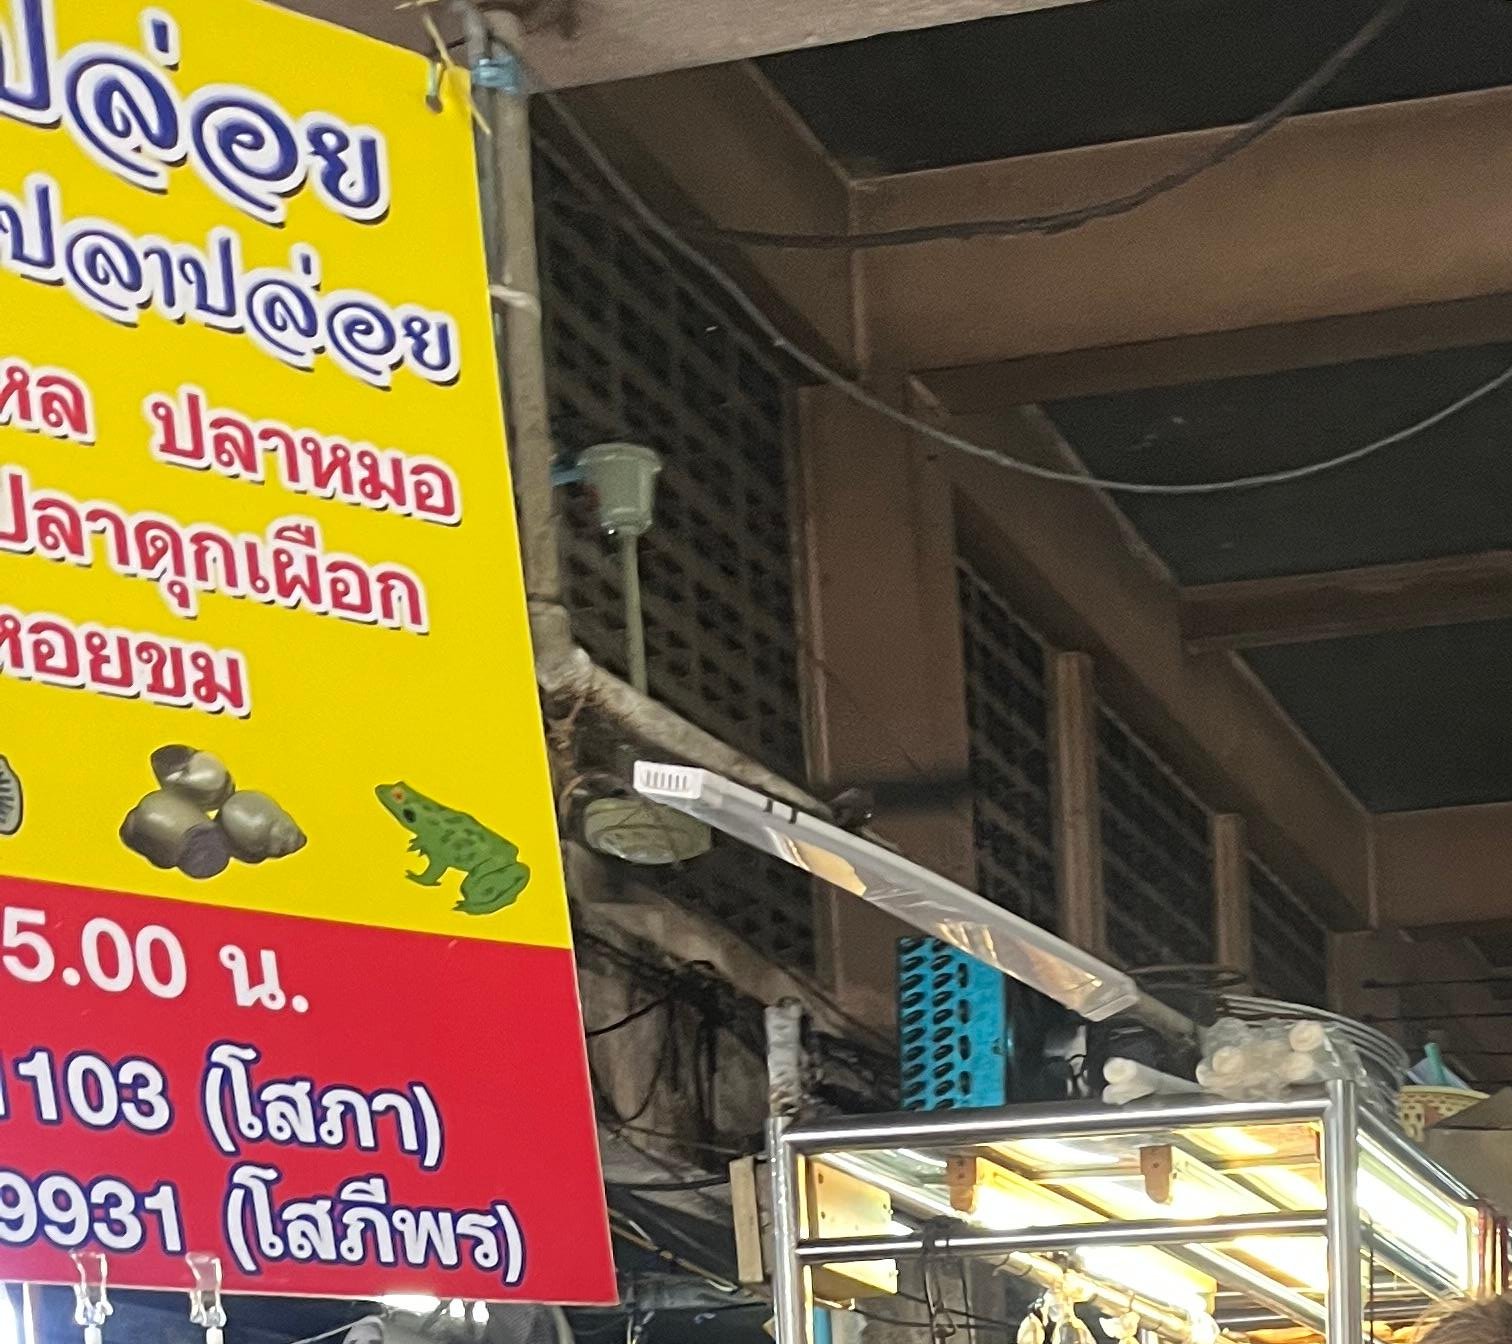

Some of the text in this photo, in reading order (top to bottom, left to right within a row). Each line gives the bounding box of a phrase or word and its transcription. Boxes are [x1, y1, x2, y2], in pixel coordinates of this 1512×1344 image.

[0, 183, 453, 374] ปลาปล่อย
[153, 394, 455, 516] ปลาหมอ
[2, 908, 309, 1013] 5.00 น.
[0, 1044, 443, 1167] 103 (โสภา)
[0, 1167, 524, 1284] 9931 (โสภีพร)
